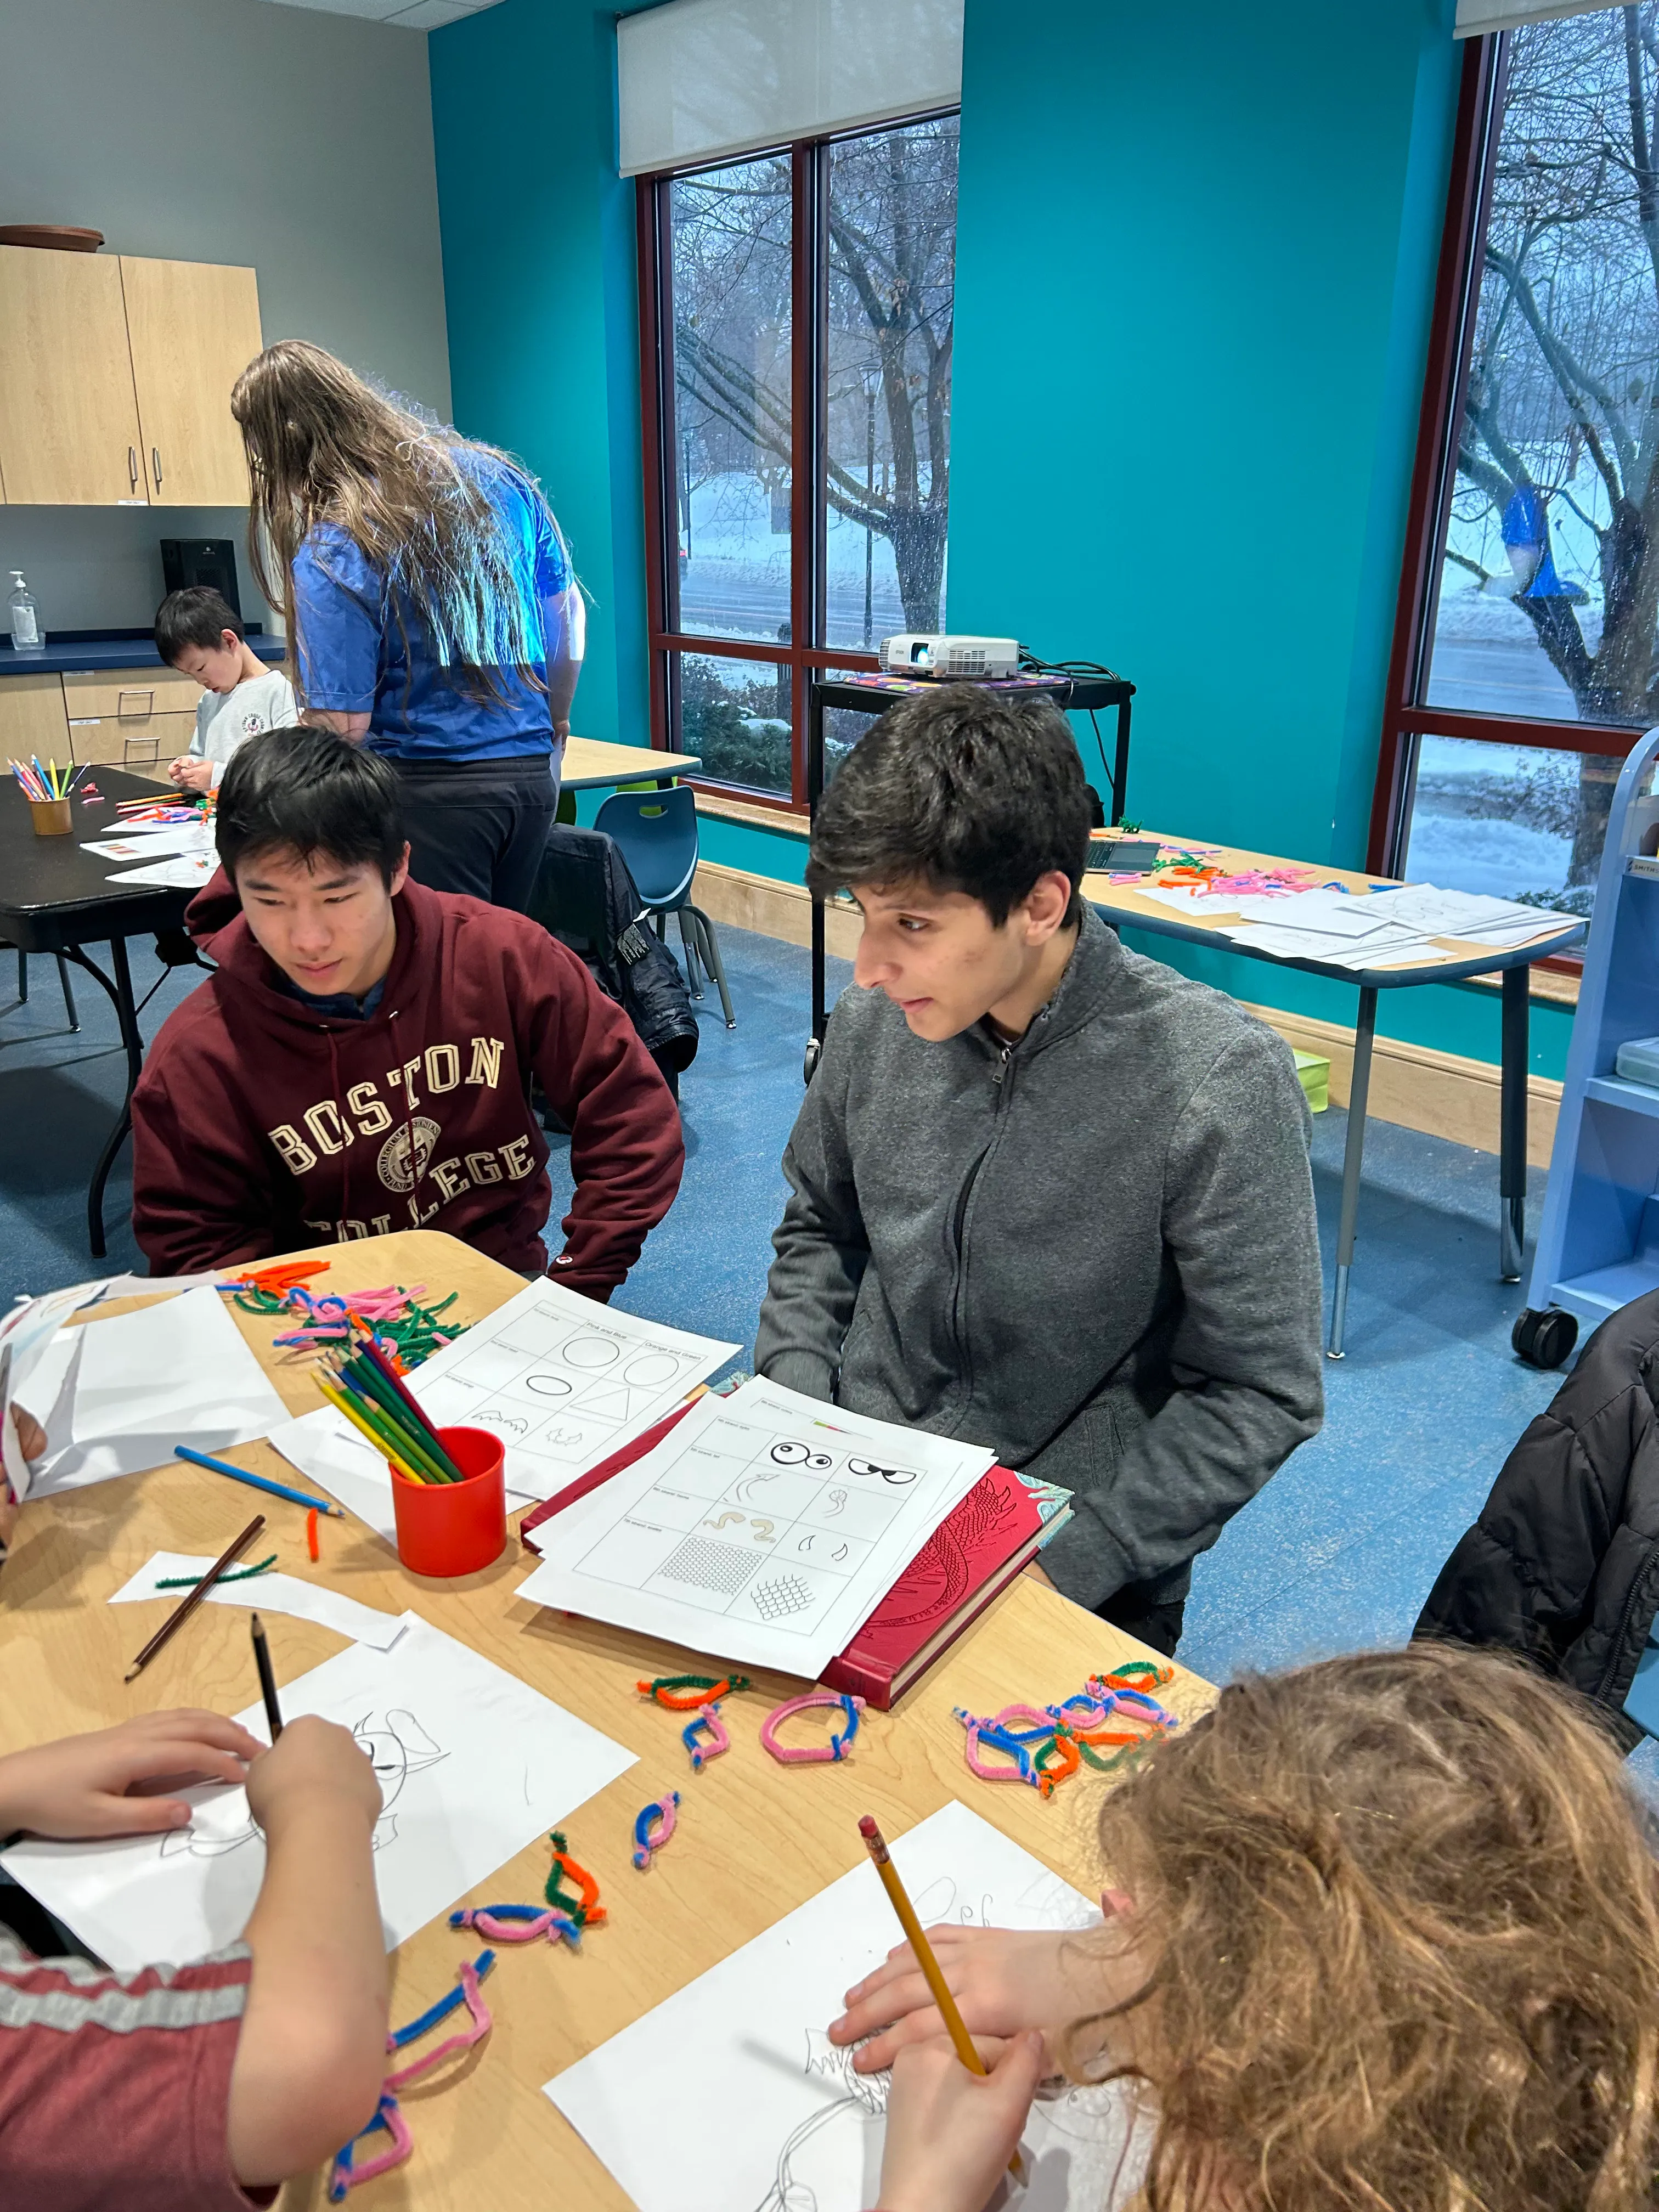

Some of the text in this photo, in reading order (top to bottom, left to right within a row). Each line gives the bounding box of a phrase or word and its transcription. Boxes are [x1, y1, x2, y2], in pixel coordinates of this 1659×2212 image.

[1634, 864, 1655, 872] SMITH
[267, 1037, 504, 1176] BOSTON
[303, 1134, 537, 1244] OLLEGE
[586, 1322, 601, 1330] Pink
[645, 1342, 668, 1351] Orange
[682, 1352, 701, 1361] Green
